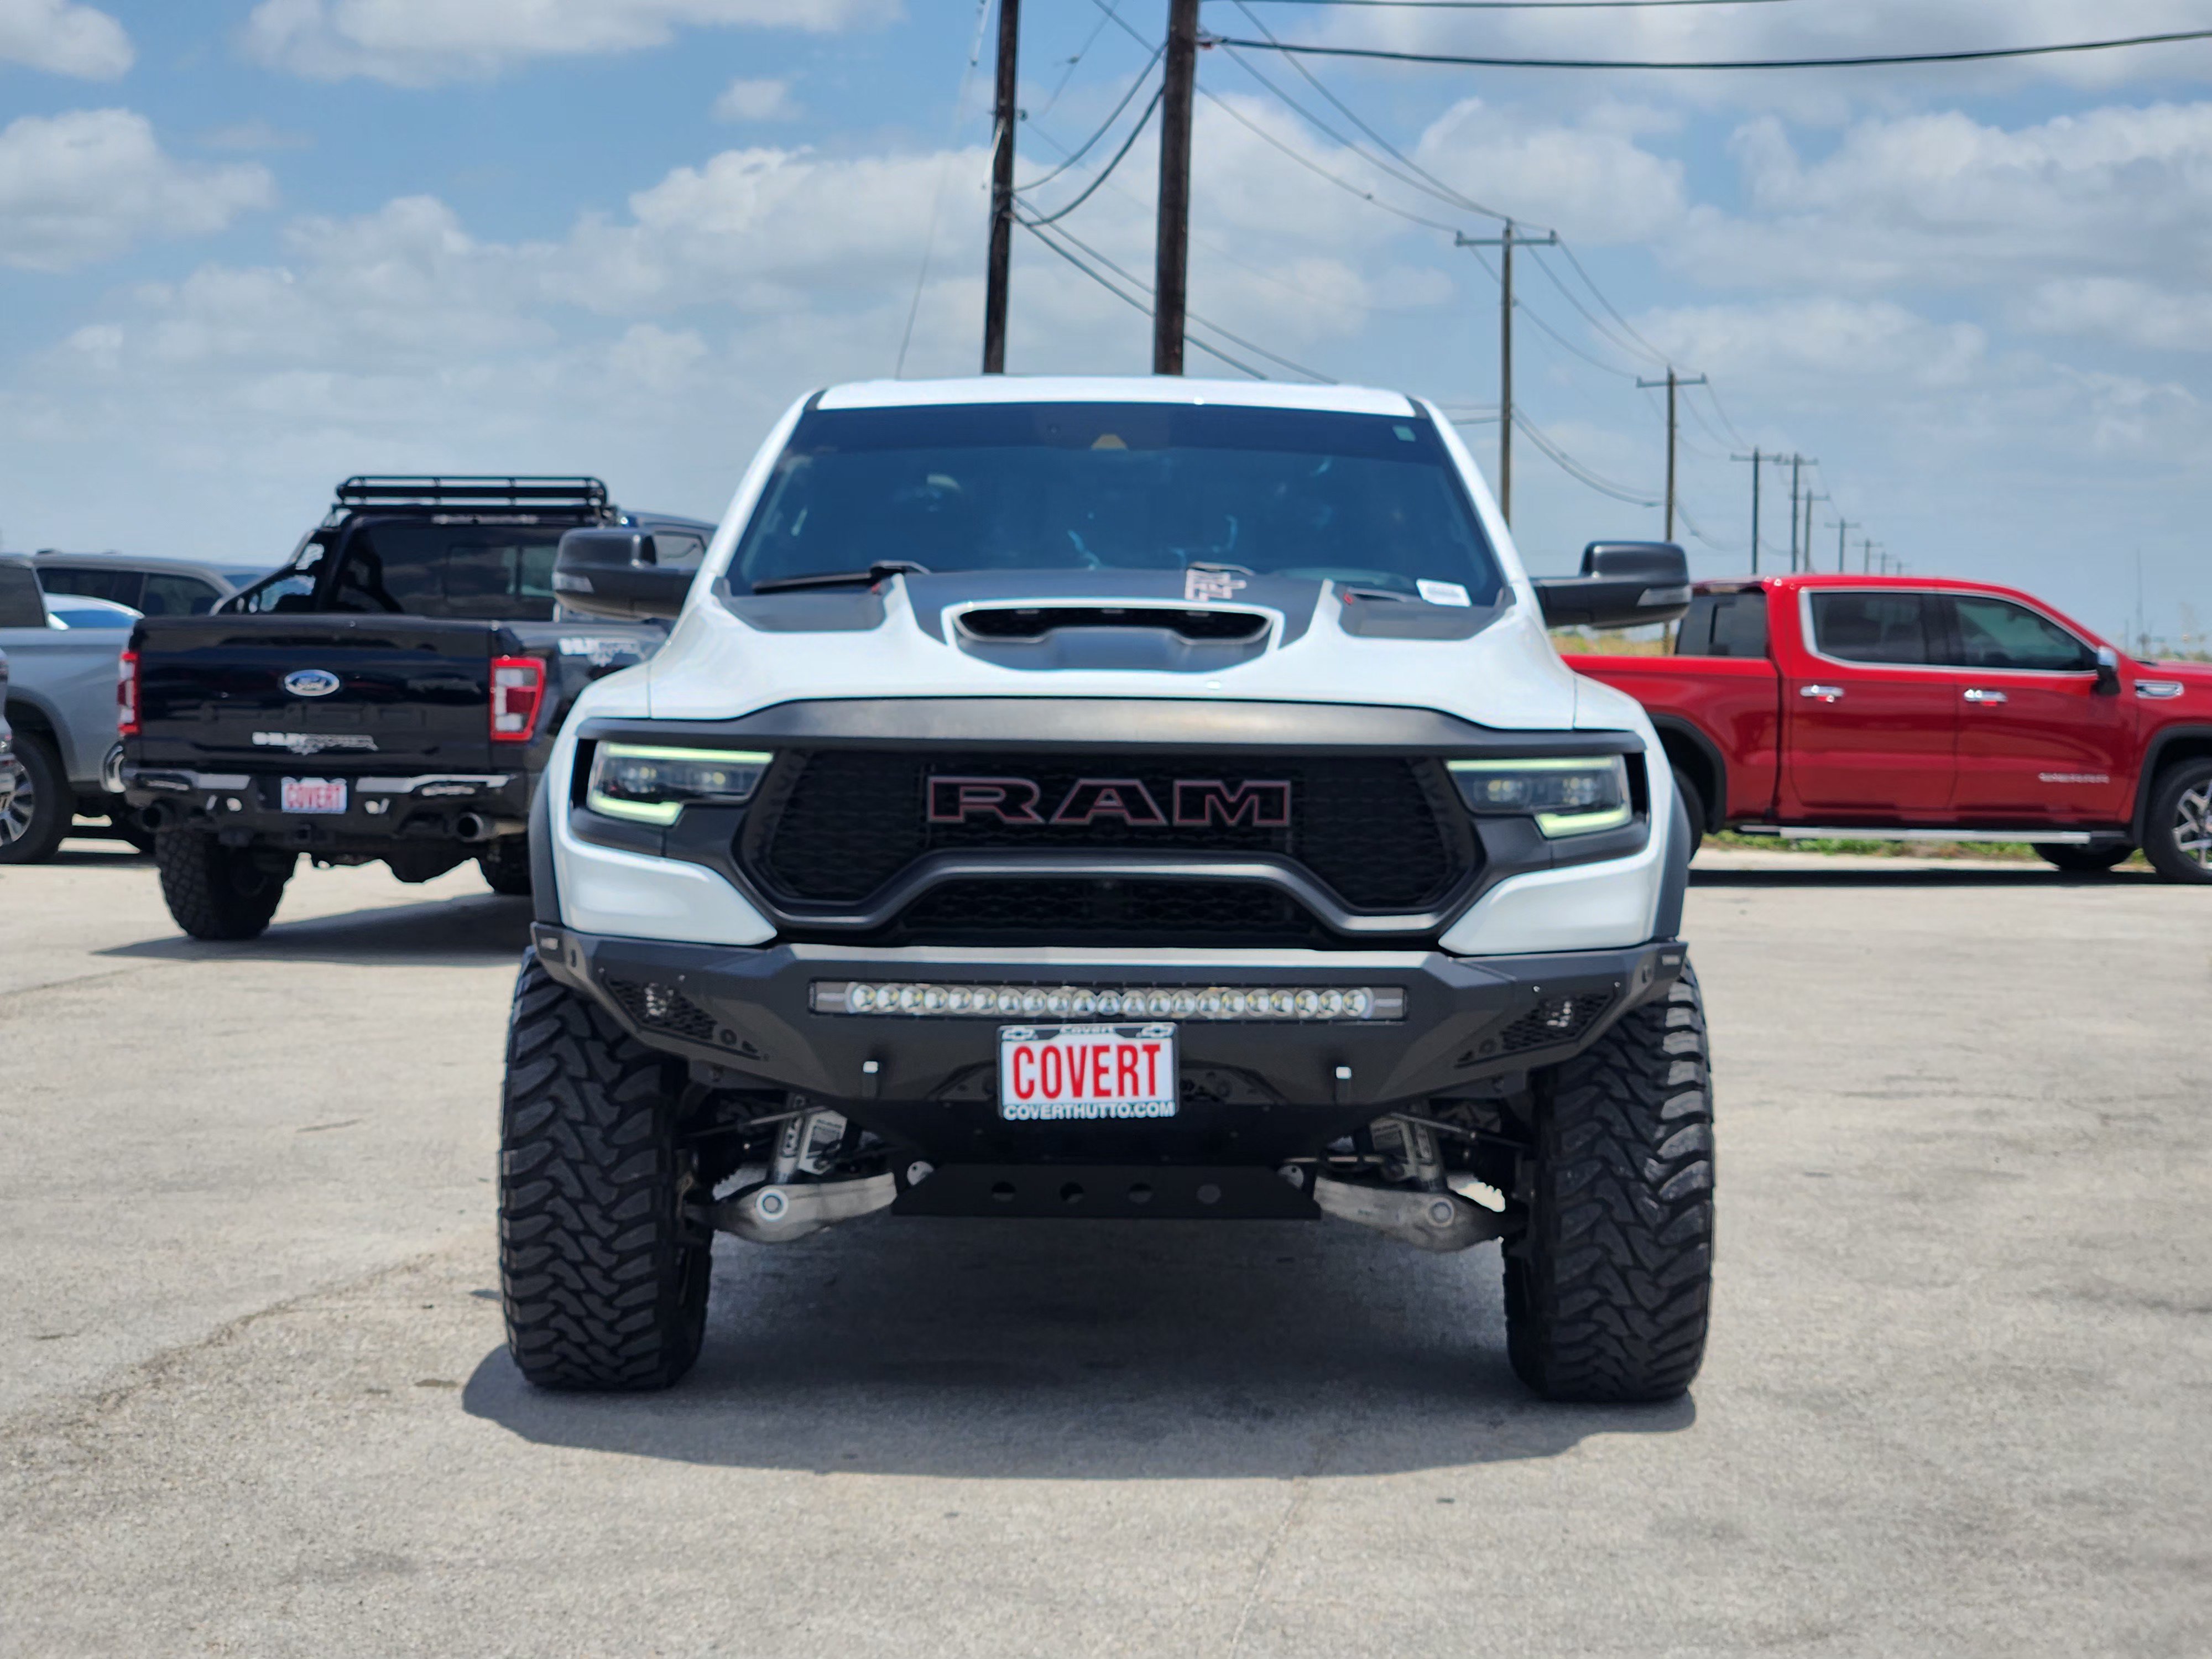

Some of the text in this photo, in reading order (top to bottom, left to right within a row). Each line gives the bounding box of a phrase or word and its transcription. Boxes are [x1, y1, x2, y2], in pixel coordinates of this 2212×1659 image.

[926, 776, 1292, 827] RAM
[1013, 1044, 1161, 1100] COVERT
[1003, 1100, 1176, 1121] COVERTHUTTO.COM
